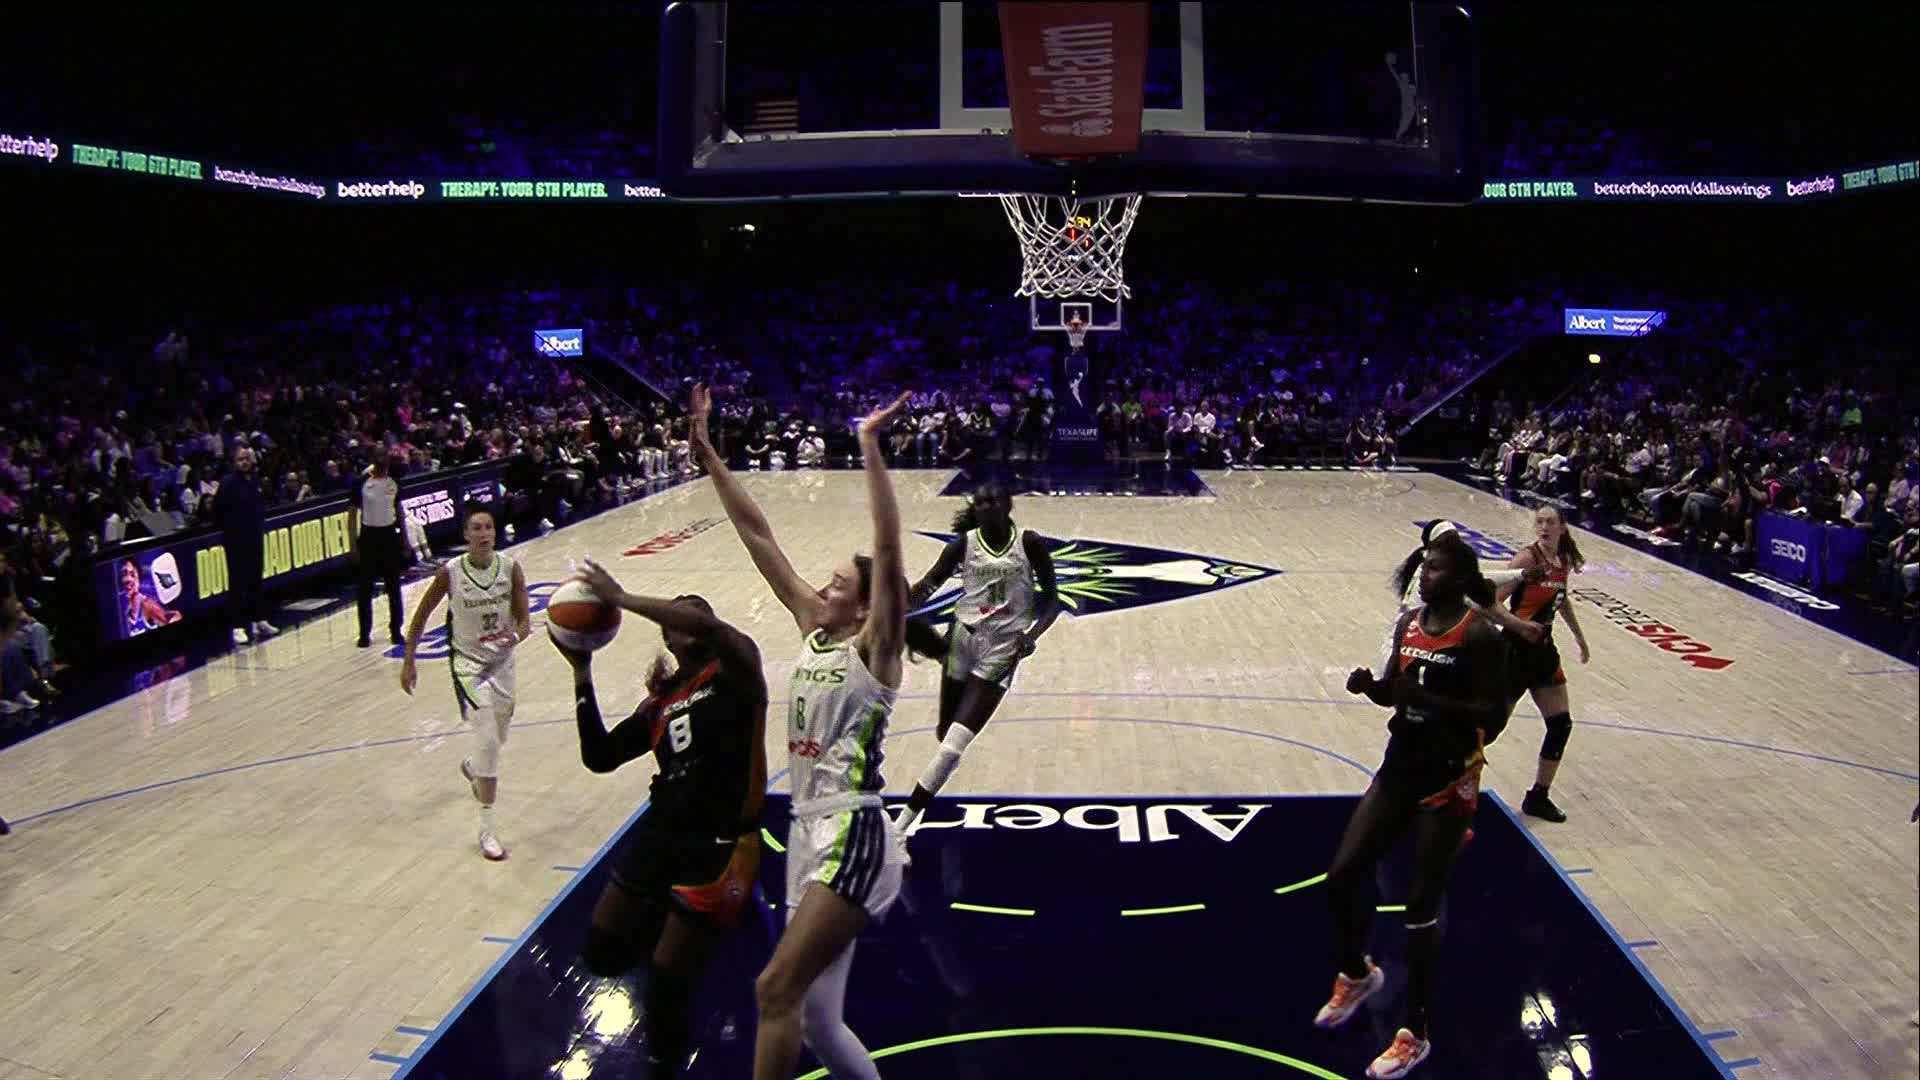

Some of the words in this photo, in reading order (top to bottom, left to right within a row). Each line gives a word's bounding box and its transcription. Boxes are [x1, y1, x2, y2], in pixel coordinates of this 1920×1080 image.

[0, 134, 59, 163] tterhelp
[338, 180, 425, 199] betterhelp
[440, 181, 499, 198] THERAPY:
[500, 181, 534, 198] YOUR
[535, 181, 560, 198] 6TH
[562, 181, 609, 198] PLAYER.
[624, 183, 666, 198] better
[1482, 182, 1507, 199] OUR
[1508, 182, 1531, 198] 6TH
[1533, 181, 1578, 198] PLAYER.
[1594, 180, 1772, 200] betterhelp.com/dallaswings
[1786, 175, 1835, 197] betterhelp
[1569, 314, 1607, 330] Albert
[1418, 665, 1426, 686] 1
[669, 714, 692, 753] 8
[888, 803, 1274, 843] Albert
